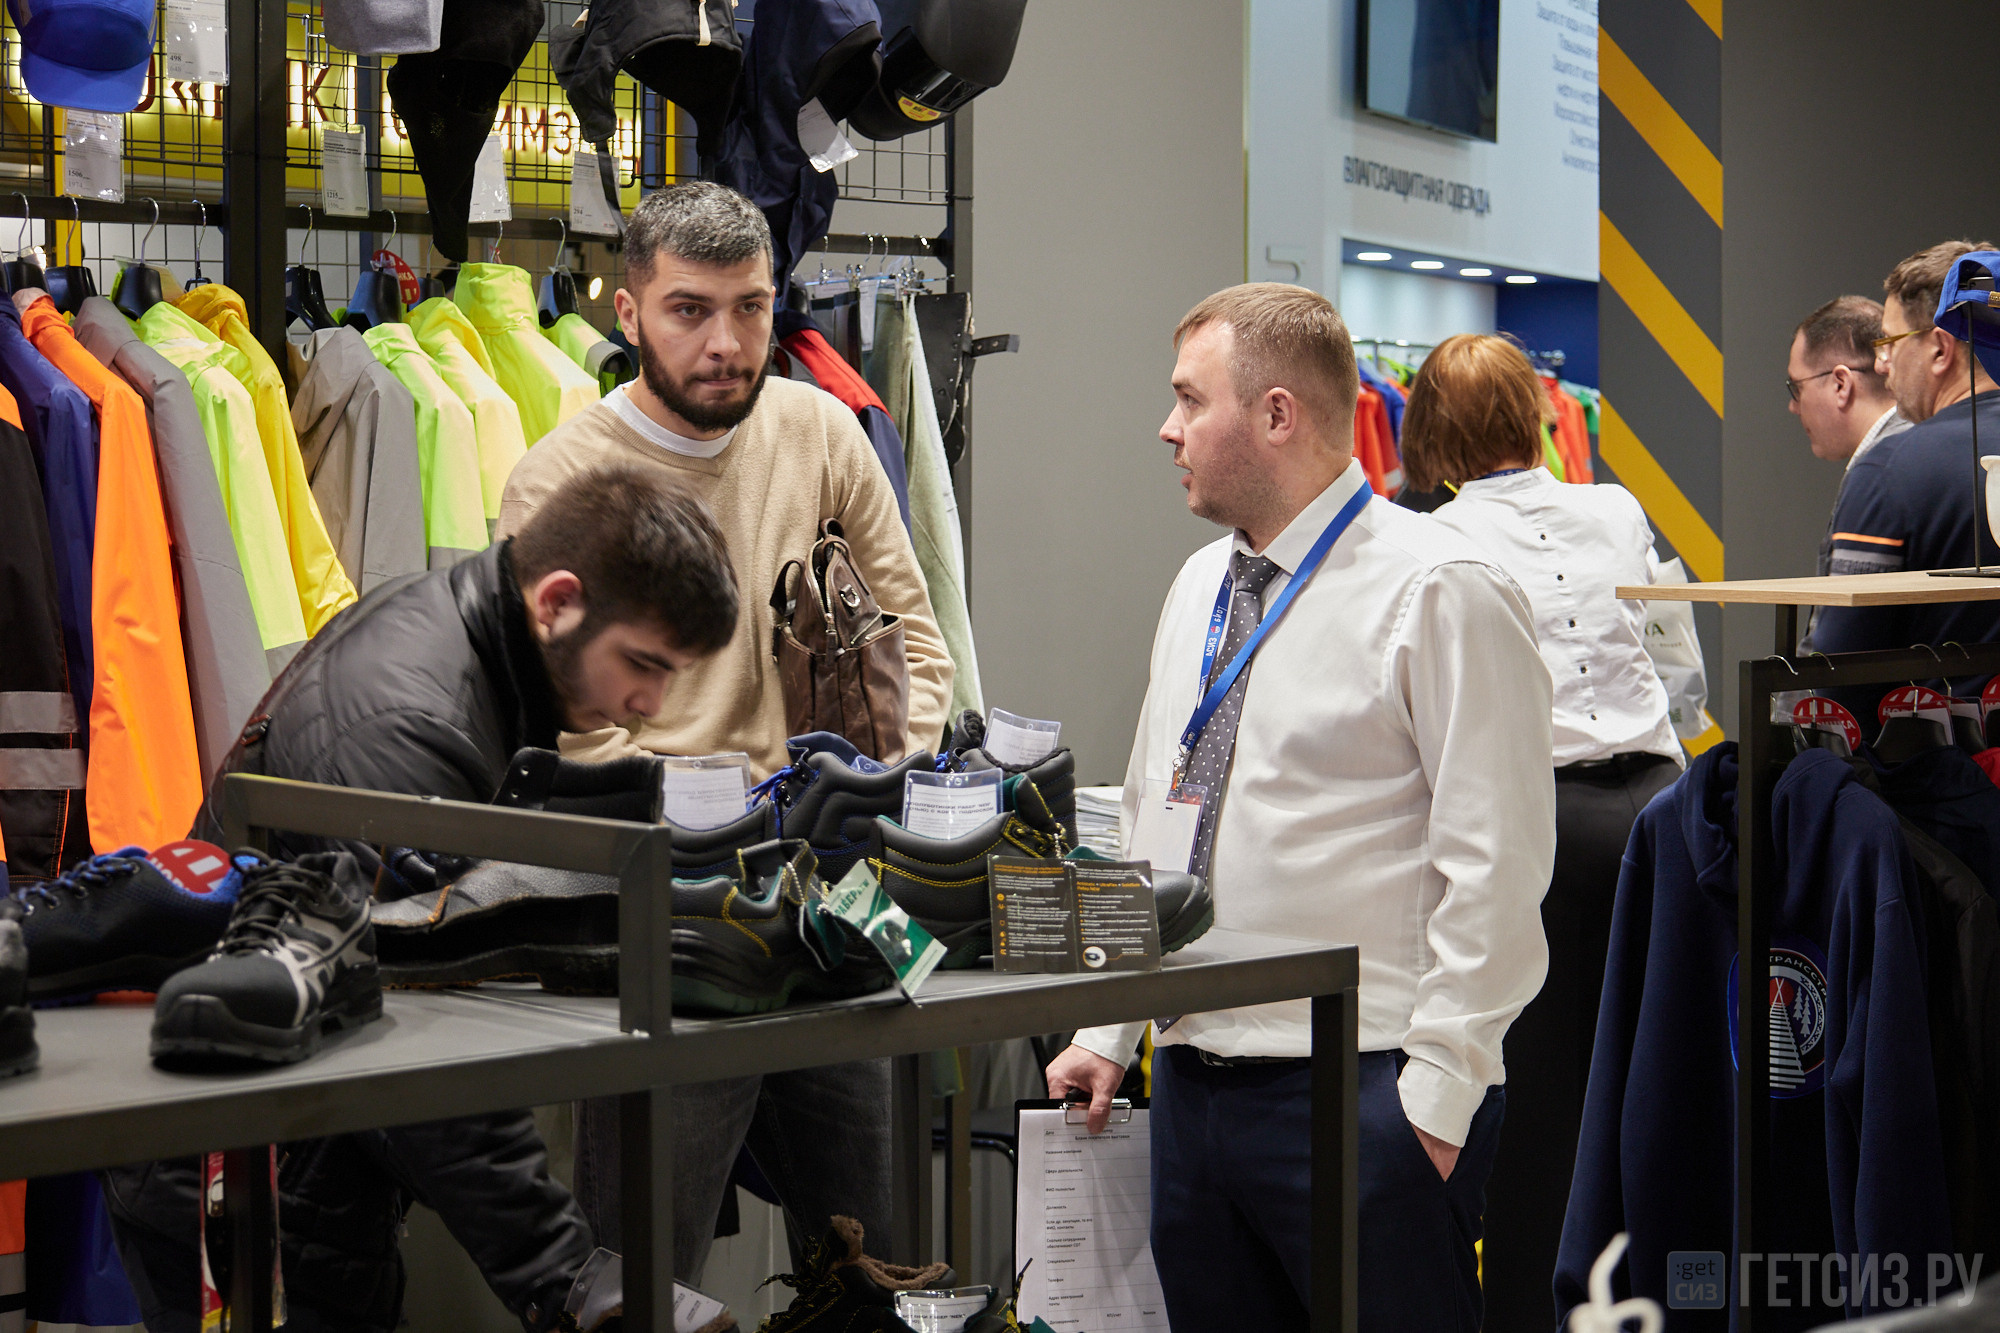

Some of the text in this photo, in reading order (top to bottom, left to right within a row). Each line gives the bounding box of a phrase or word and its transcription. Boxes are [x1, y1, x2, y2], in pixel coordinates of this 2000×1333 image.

[1344, 156, 1491, 217] ВЛАГОЗАЩИТНАЯ ОДЕЖДА
[1205, 637, 1217, 657] АСИЗ
